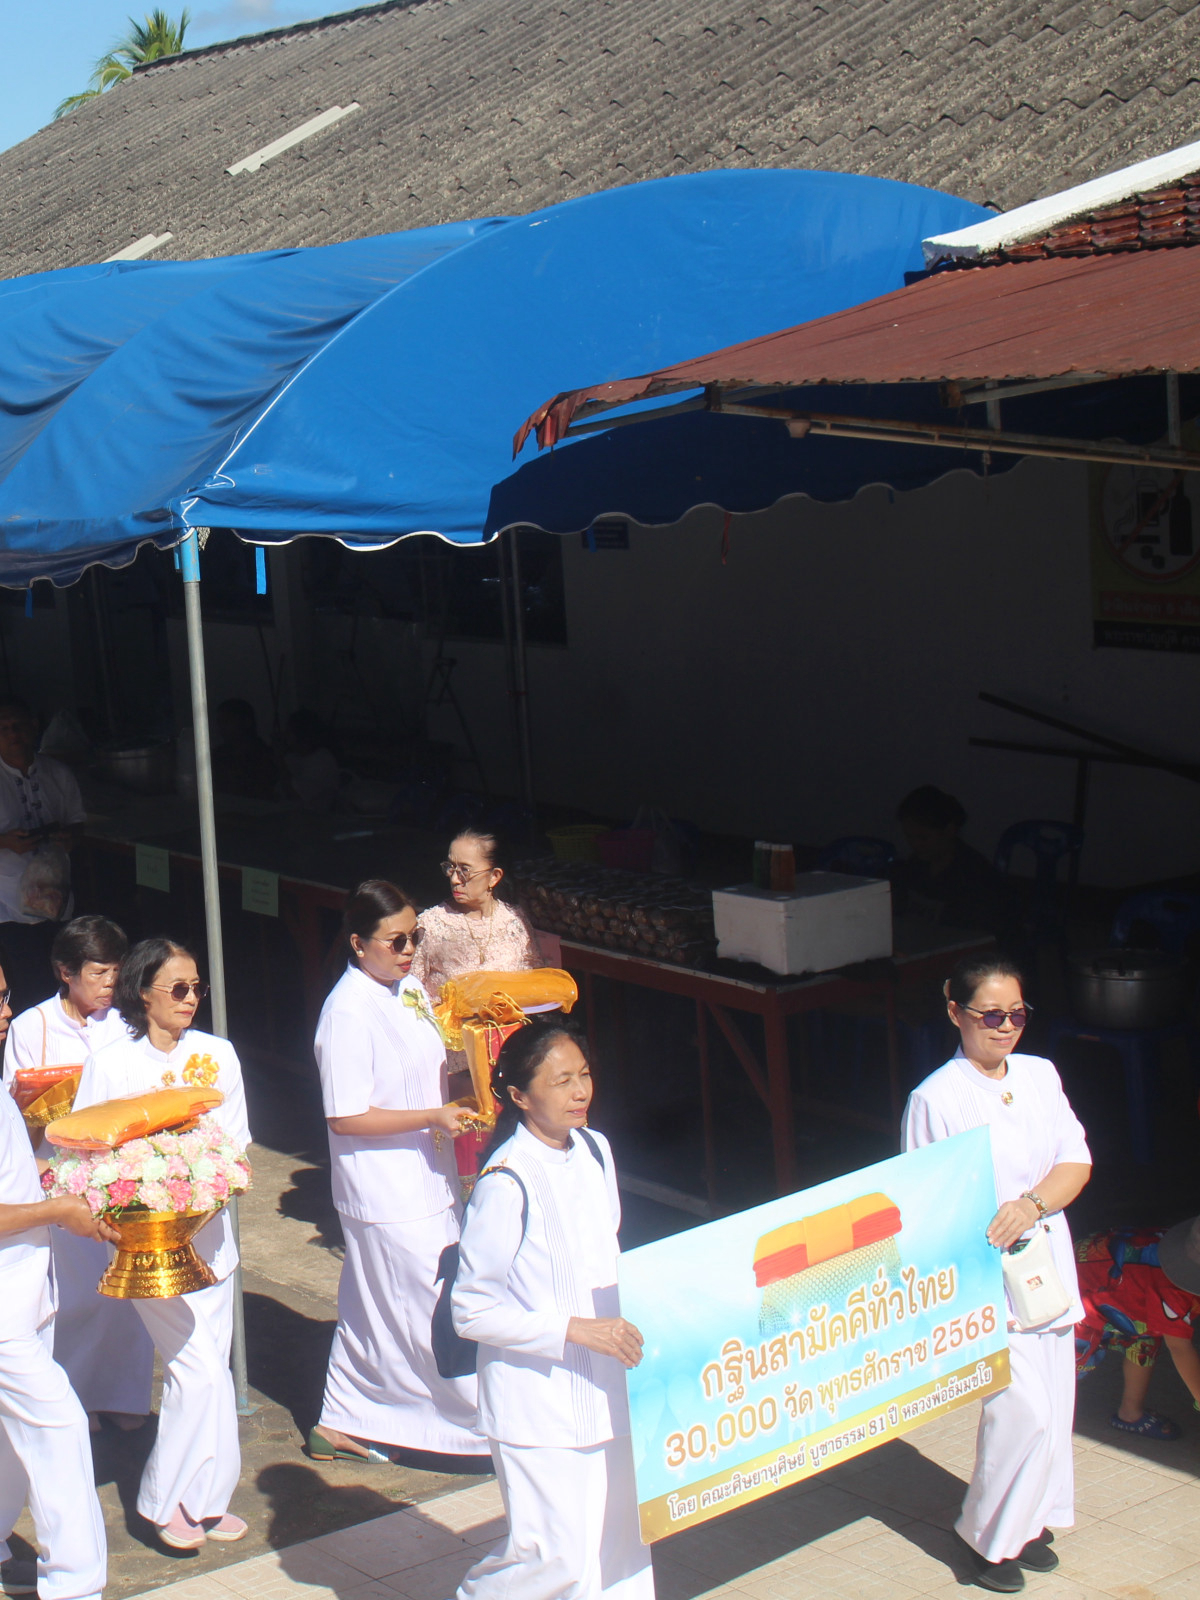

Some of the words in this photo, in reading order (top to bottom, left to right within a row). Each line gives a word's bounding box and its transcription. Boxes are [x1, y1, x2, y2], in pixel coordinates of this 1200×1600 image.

[665, 1396, 778, 1468] 30,000
[784, 1383, 814, 1418] วัด
[817, 1338, 928, 1414] พุทธศักราช
[932, 1305, 996, 1356] 2568
[702, 1265, 955, 1404] กฐินสามัคคีทั่วไทย
[667, 1494, 696, 1519] โดย
[701, 1444, 806, 1507] คณะศิษยานุศิษย์
[809, 1425, 866, 1467] บูชาธรรม
[869, 1416, 886, 1436] 81
[888, 1406, 899, 1426] ปี
[902, 1363, 992, 1420] หลวงพ่อธัมมชโย
